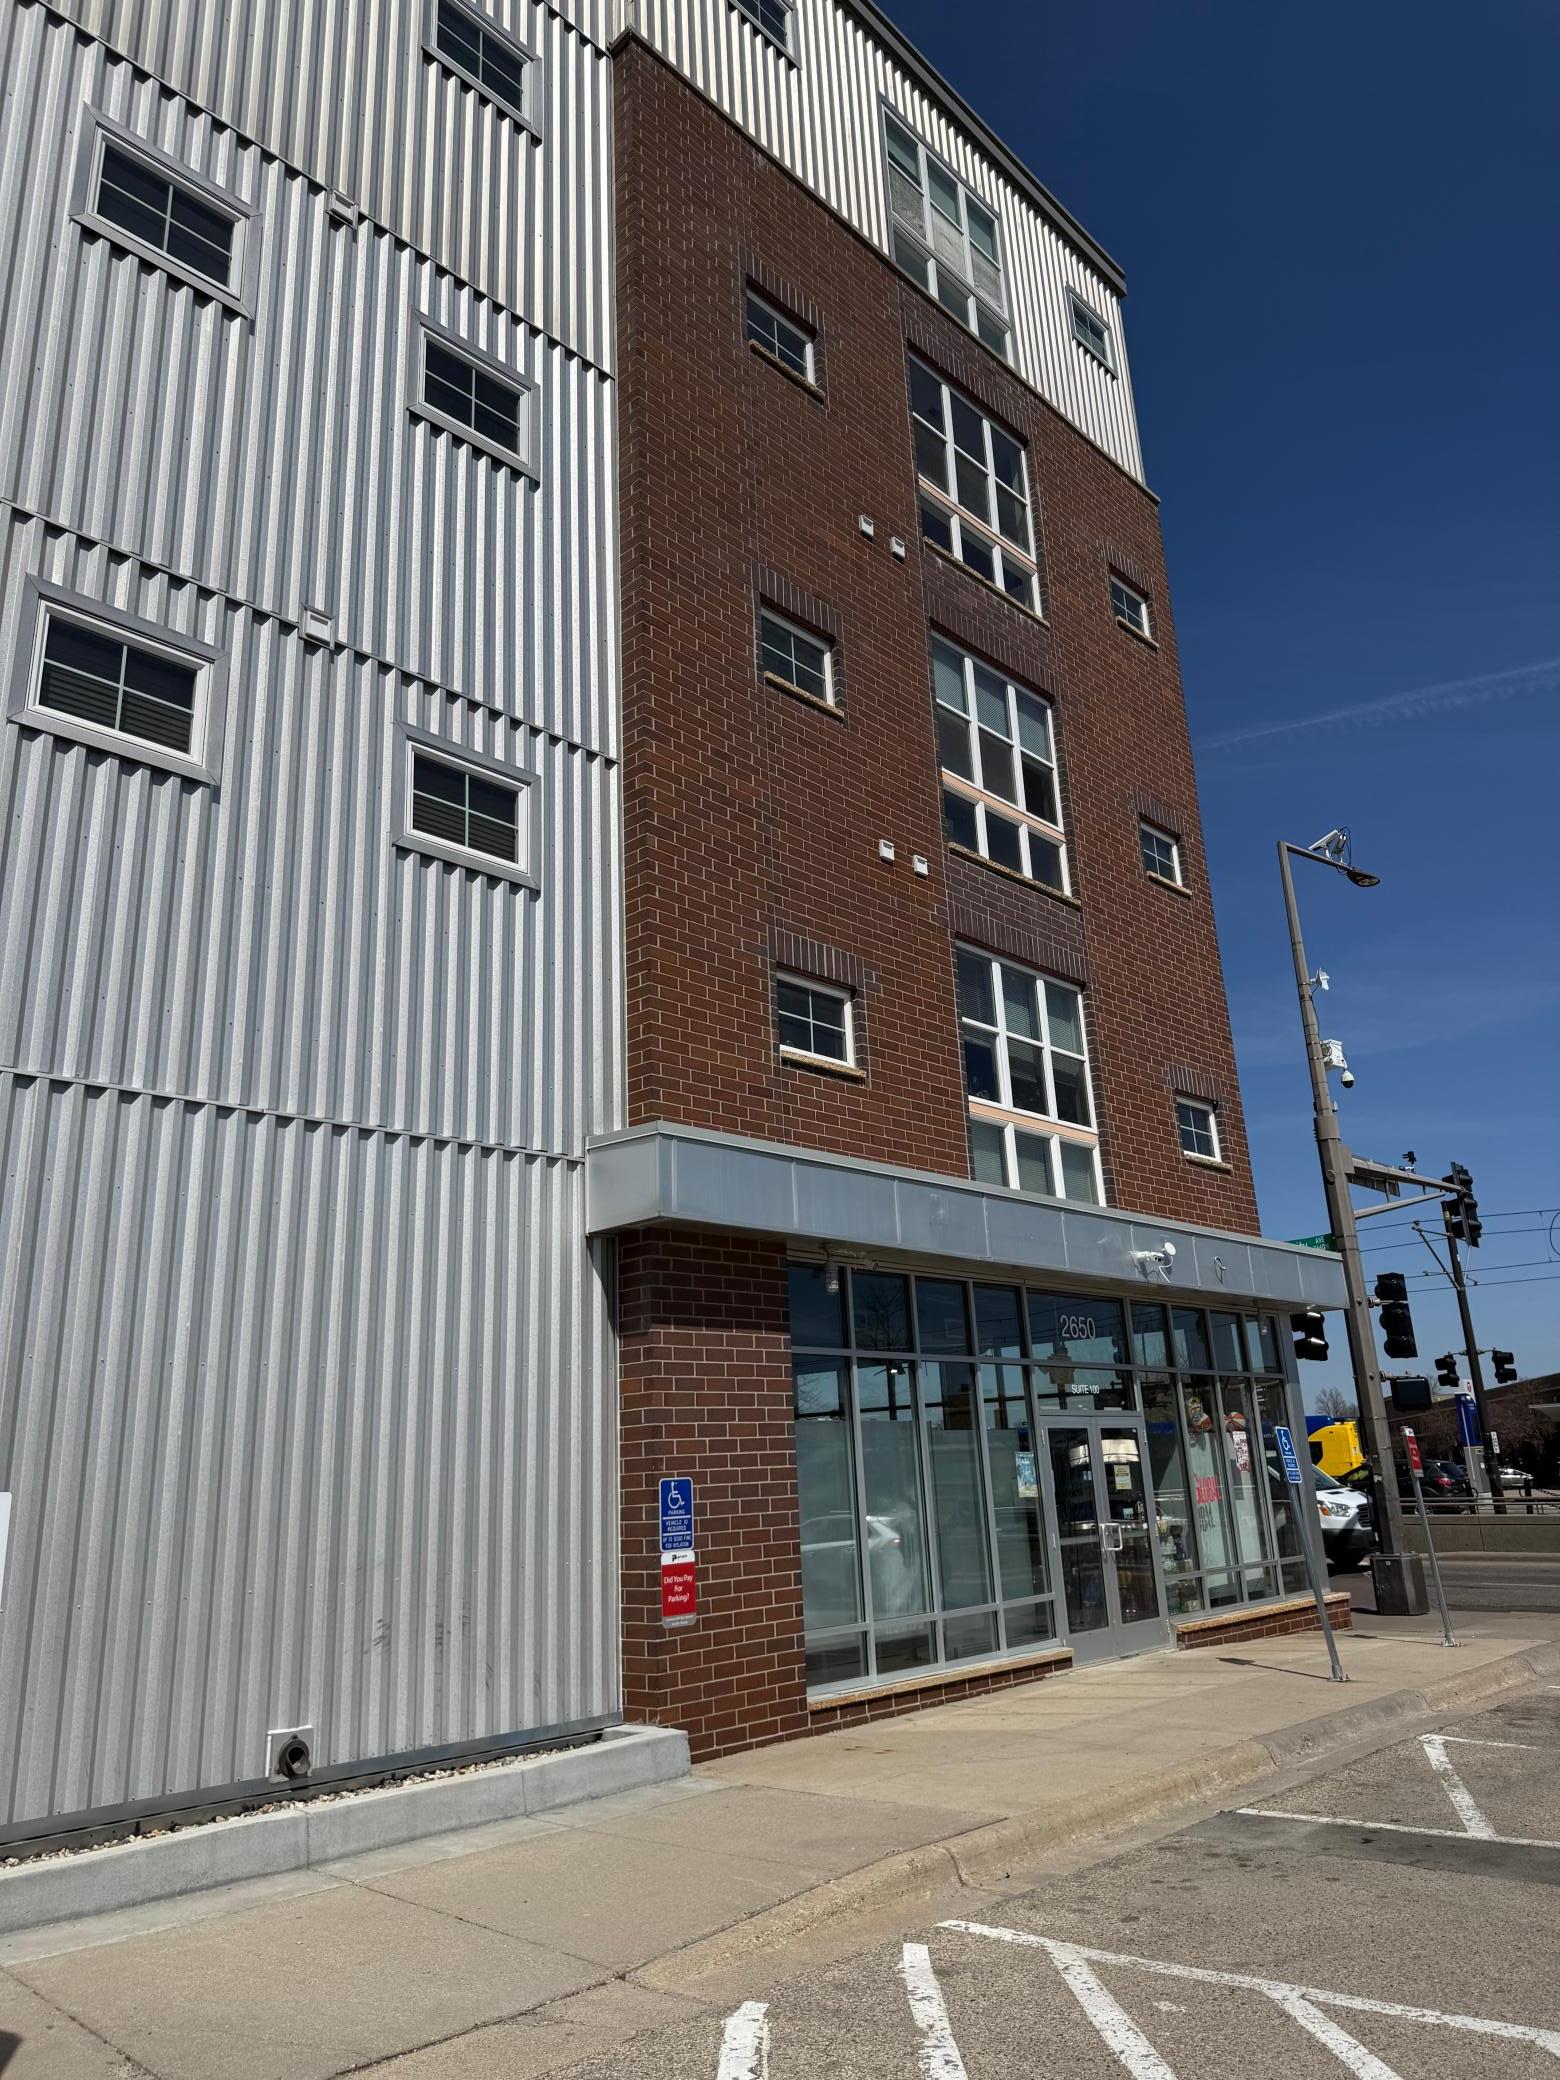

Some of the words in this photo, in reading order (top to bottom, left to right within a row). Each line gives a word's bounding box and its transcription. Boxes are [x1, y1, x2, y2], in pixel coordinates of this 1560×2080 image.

[1060, 1315, 1095, 1339] 2650
[1072, 1385, 1088, 1394] SUITE
[1089, 1385, 1100, 1394] 100
[664, 1576, 673, 1584] Did
[674, 1575, 683, 1583] You
[684, 1574, 693, 1582] Pay
[668, 1593, 690, 1603] Parking?
